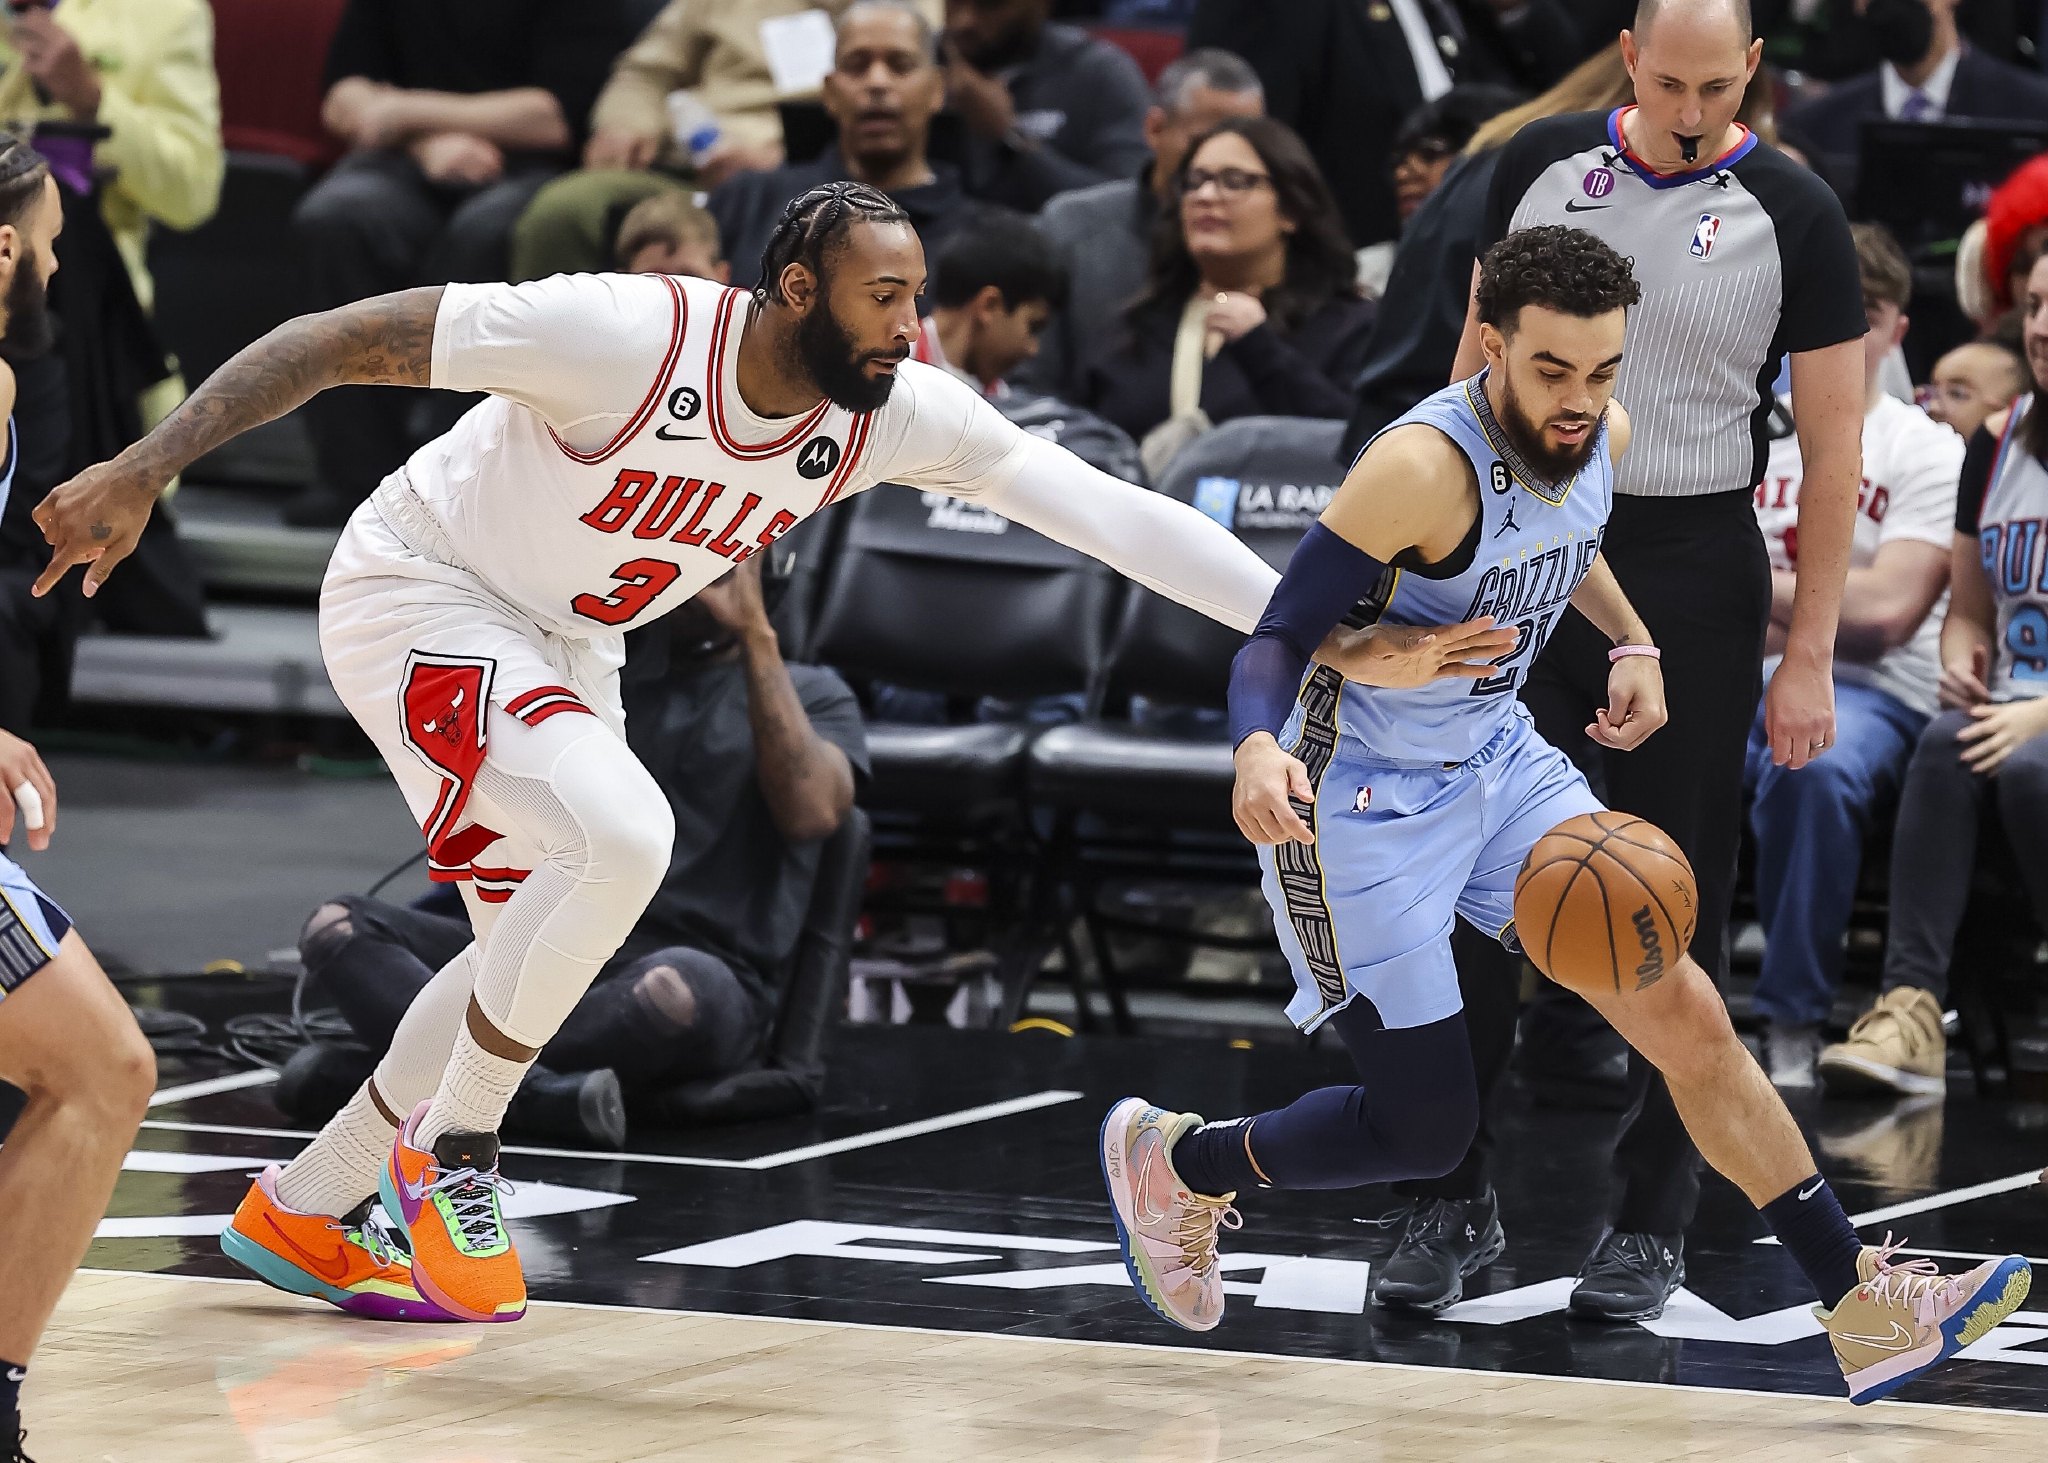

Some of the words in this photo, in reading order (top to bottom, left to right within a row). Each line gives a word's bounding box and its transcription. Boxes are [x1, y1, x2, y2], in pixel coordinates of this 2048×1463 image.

[1588, 170, 1609, 197] TB
[672, 392, 696, 417] 6
[1492, 465, 1507, 491] 6
[1502, 526, 1598, 569] MEMPHIS
[570, 557, 682, 626] 3
